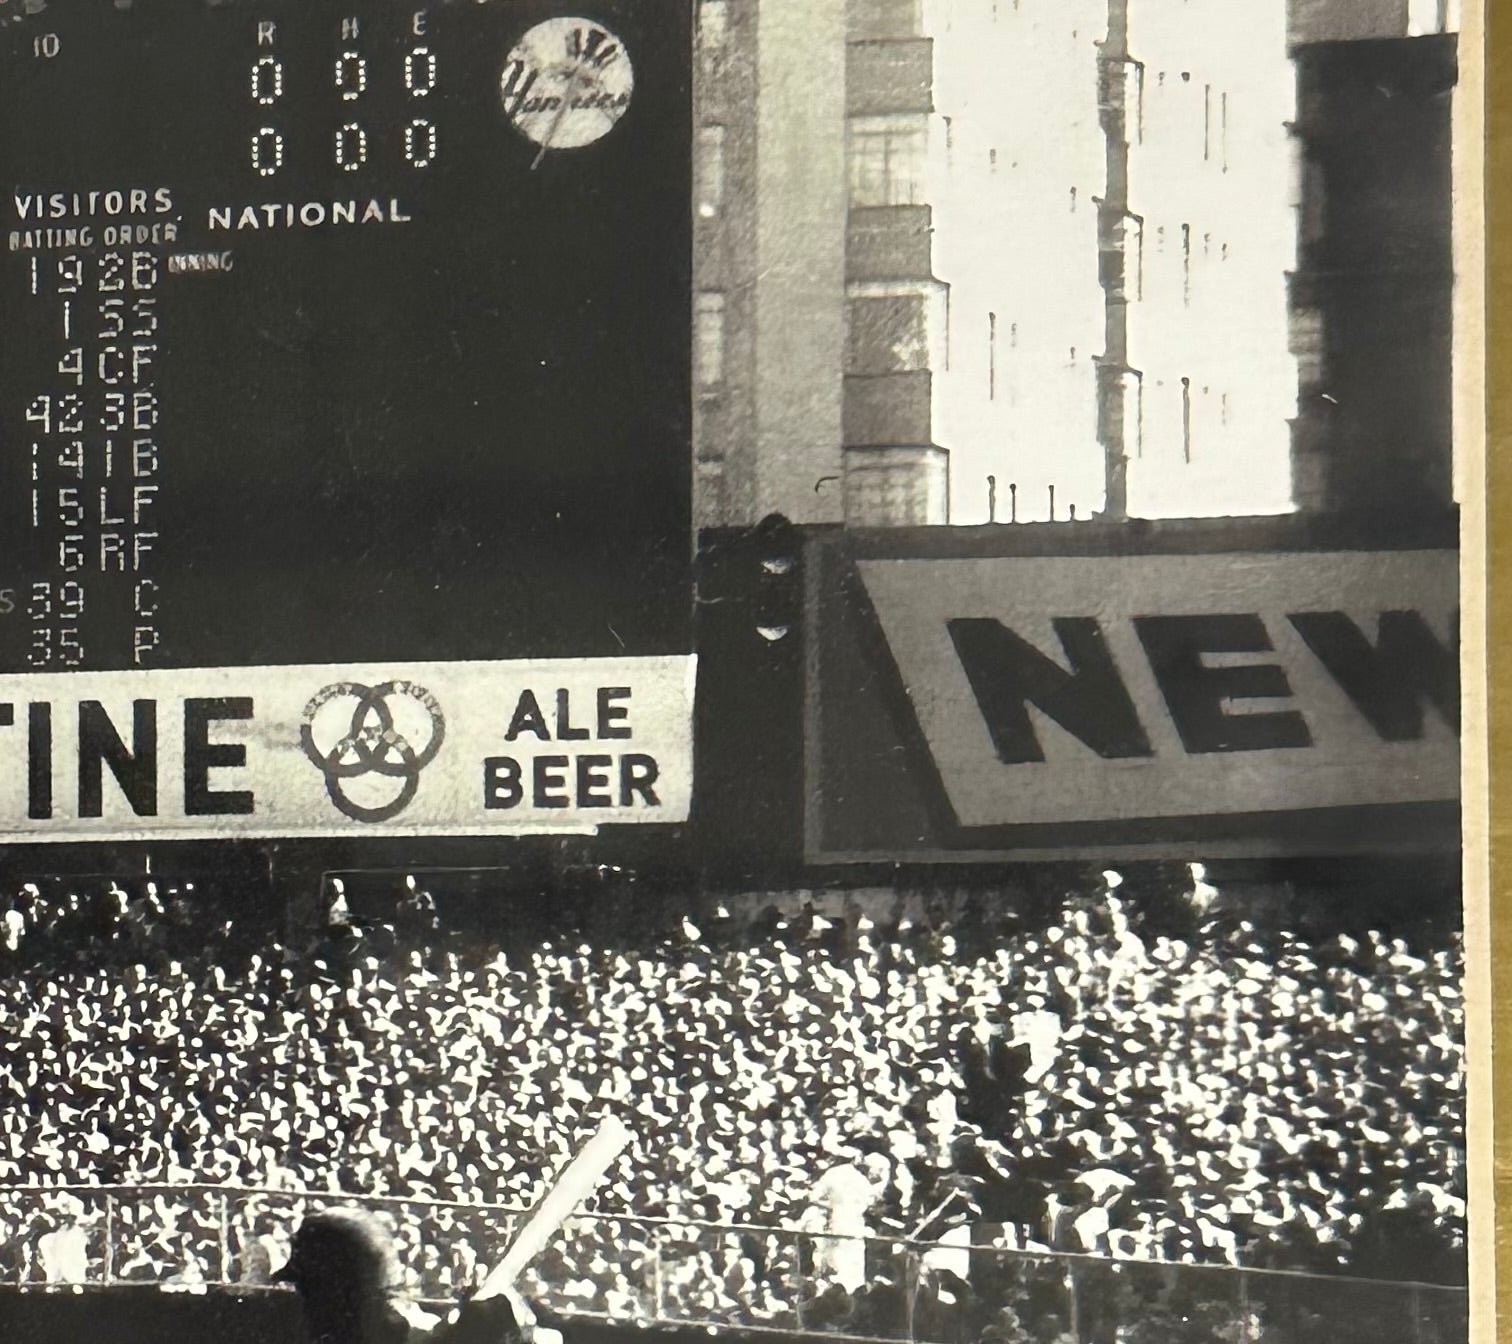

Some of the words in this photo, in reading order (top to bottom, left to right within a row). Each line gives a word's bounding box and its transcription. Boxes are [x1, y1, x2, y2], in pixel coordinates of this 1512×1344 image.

[33, 33, 61, 58] 10
[257, 22, 277, 47] R
[341, 18, 358, 40] H
[413, 13, 427, 34] E
[250, 57, 284, 105] 0
[334, 52, 367, 100] 0
[404, 47, 437, 96] 0
[250, 127, 284, 177] 0
[334, 122, 367, 171] 0
[404, 119, 437, 169] 0
[15, 188, 173, 219] VISITORS
[209, 199, 411, 231] NATIONAL
[104, 223, 177, 245] ORDER
[134, 580, 159, 616] C
[944, 609, 1461, 765] NEW
[504, 686, 633, 741] ALE
[483, 753, 661, 810] BEER
